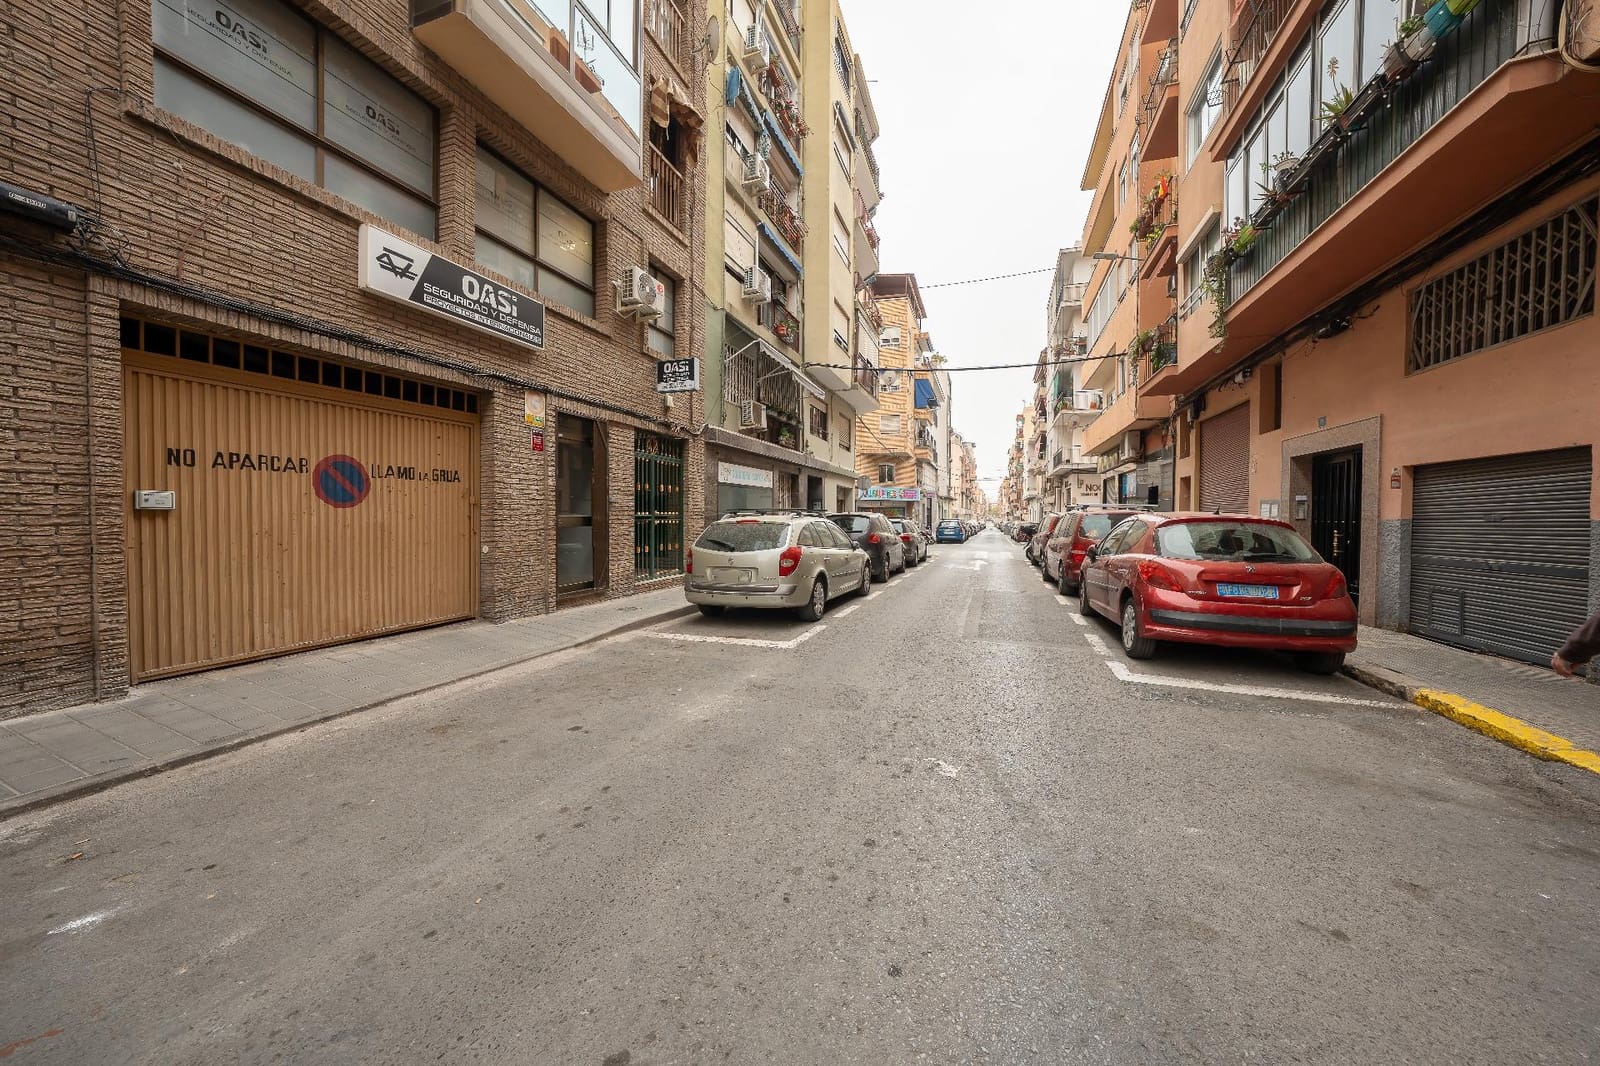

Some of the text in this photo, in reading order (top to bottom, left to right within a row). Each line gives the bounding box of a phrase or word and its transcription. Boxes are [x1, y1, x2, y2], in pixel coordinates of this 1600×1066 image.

[423, 282, 542, 336] SEGURIDAD Y DEFENSA
[424, 294, 476, 319] PROYECTOS
[167, 447, 309, 473] NO APARCAR
[371, 463, 415, 480] LLAMO
[432, 468, 461, 483] GRUA
